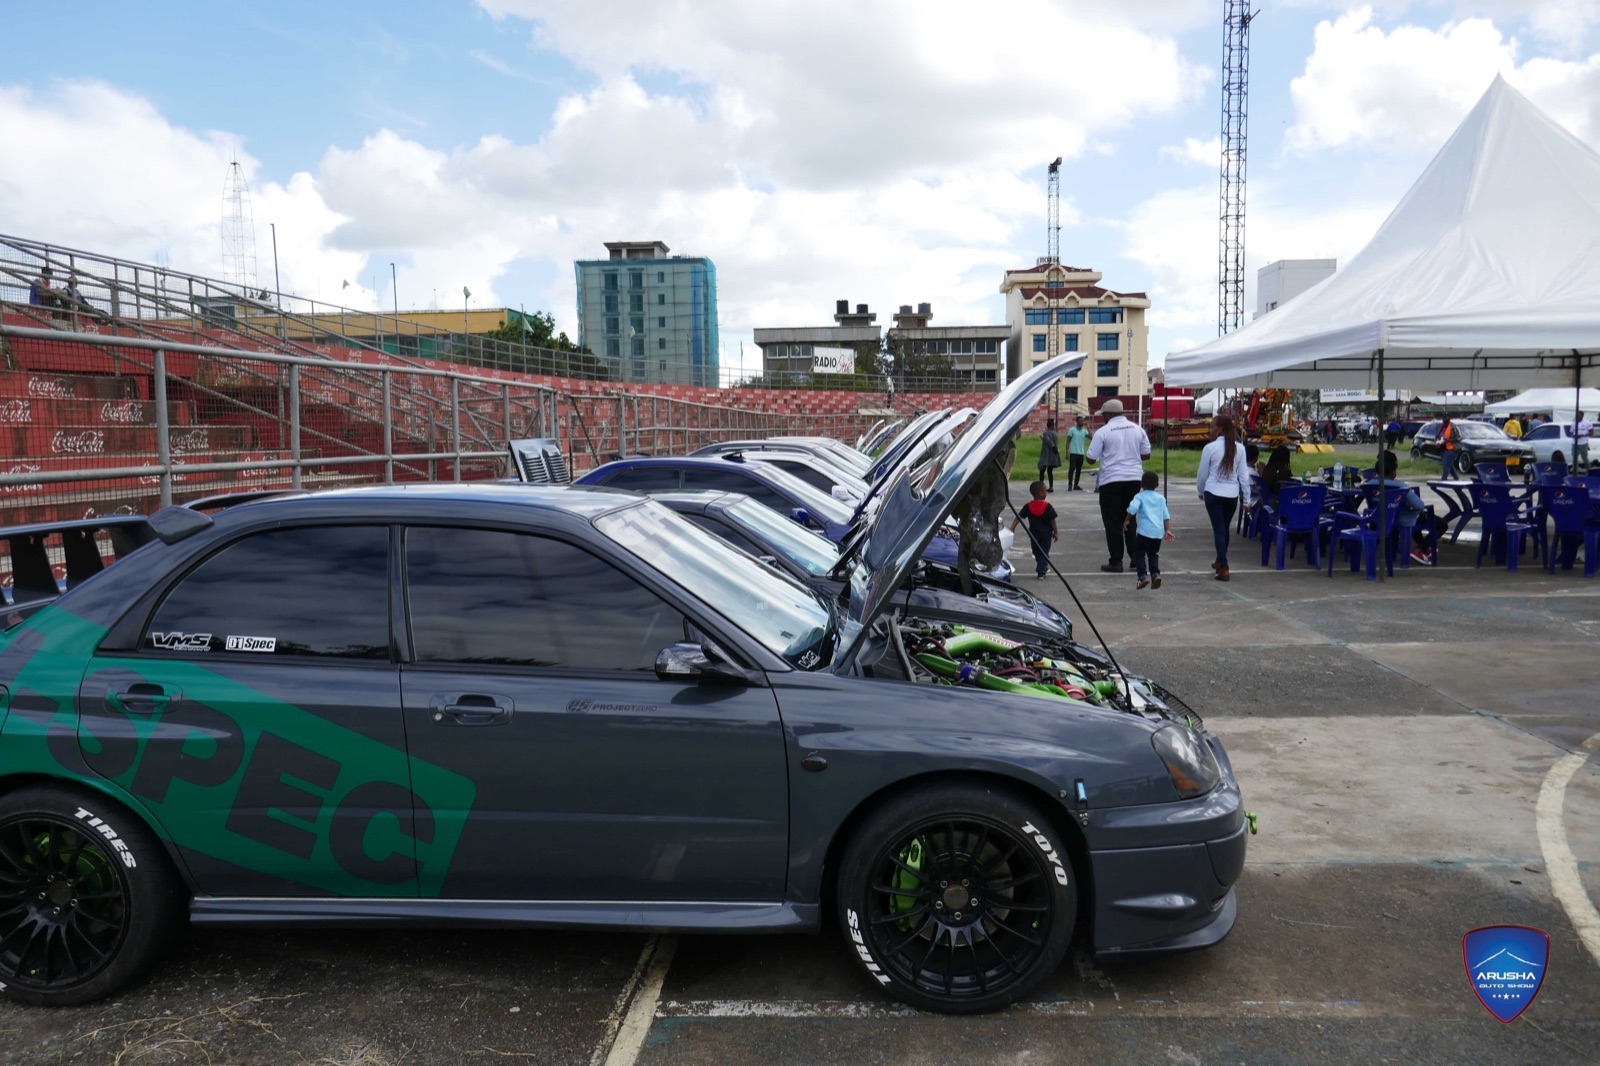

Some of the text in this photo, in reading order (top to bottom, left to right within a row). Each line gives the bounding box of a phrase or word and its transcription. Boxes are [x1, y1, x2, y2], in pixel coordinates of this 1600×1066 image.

[814, 356, 837, 368] RADIO
[152, 631, 212, 649] VMS
[74, 807, 137, 868] TIRES
[1021, 821, 1068, 886] TOYO
[847, 908, 892, 986] TIRES
